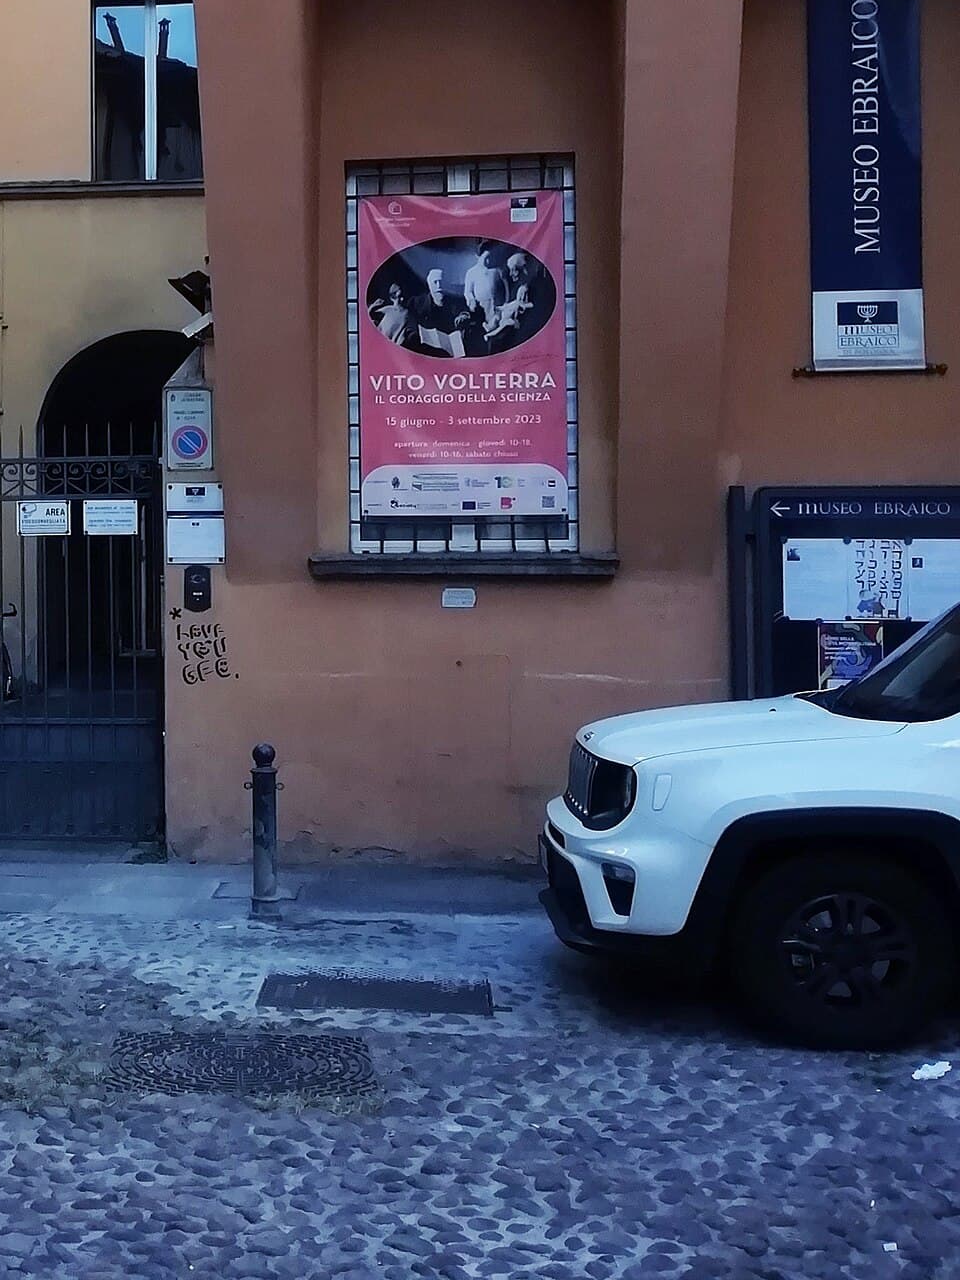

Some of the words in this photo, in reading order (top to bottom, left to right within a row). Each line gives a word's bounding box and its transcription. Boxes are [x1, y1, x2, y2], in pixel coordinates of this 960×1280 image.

[852, 144, 881, 256] MUSEO
[840, 336, 897, 348] EBRAICO
[370, 374, 425, 391] VITO
[434, 372, 557, 390] VOLTERRA
[375, 395, 385, 404] IL
[389, 393, 454, 404] CORAGGIO
[458, 393, 497, 403] DELLA
[500, 392, 551, 402] SCIENZA
[385, 417, 397, 426] 15
[400, 417, 436, 428] giugno
[448, 416, 454, 425] 3
[457, 415, 511, 425] settembre
[515, 414, 542, 424] 2023
[45, 508, 66, 517] AREA
[874, 501, 951, 517] EBRAICO
